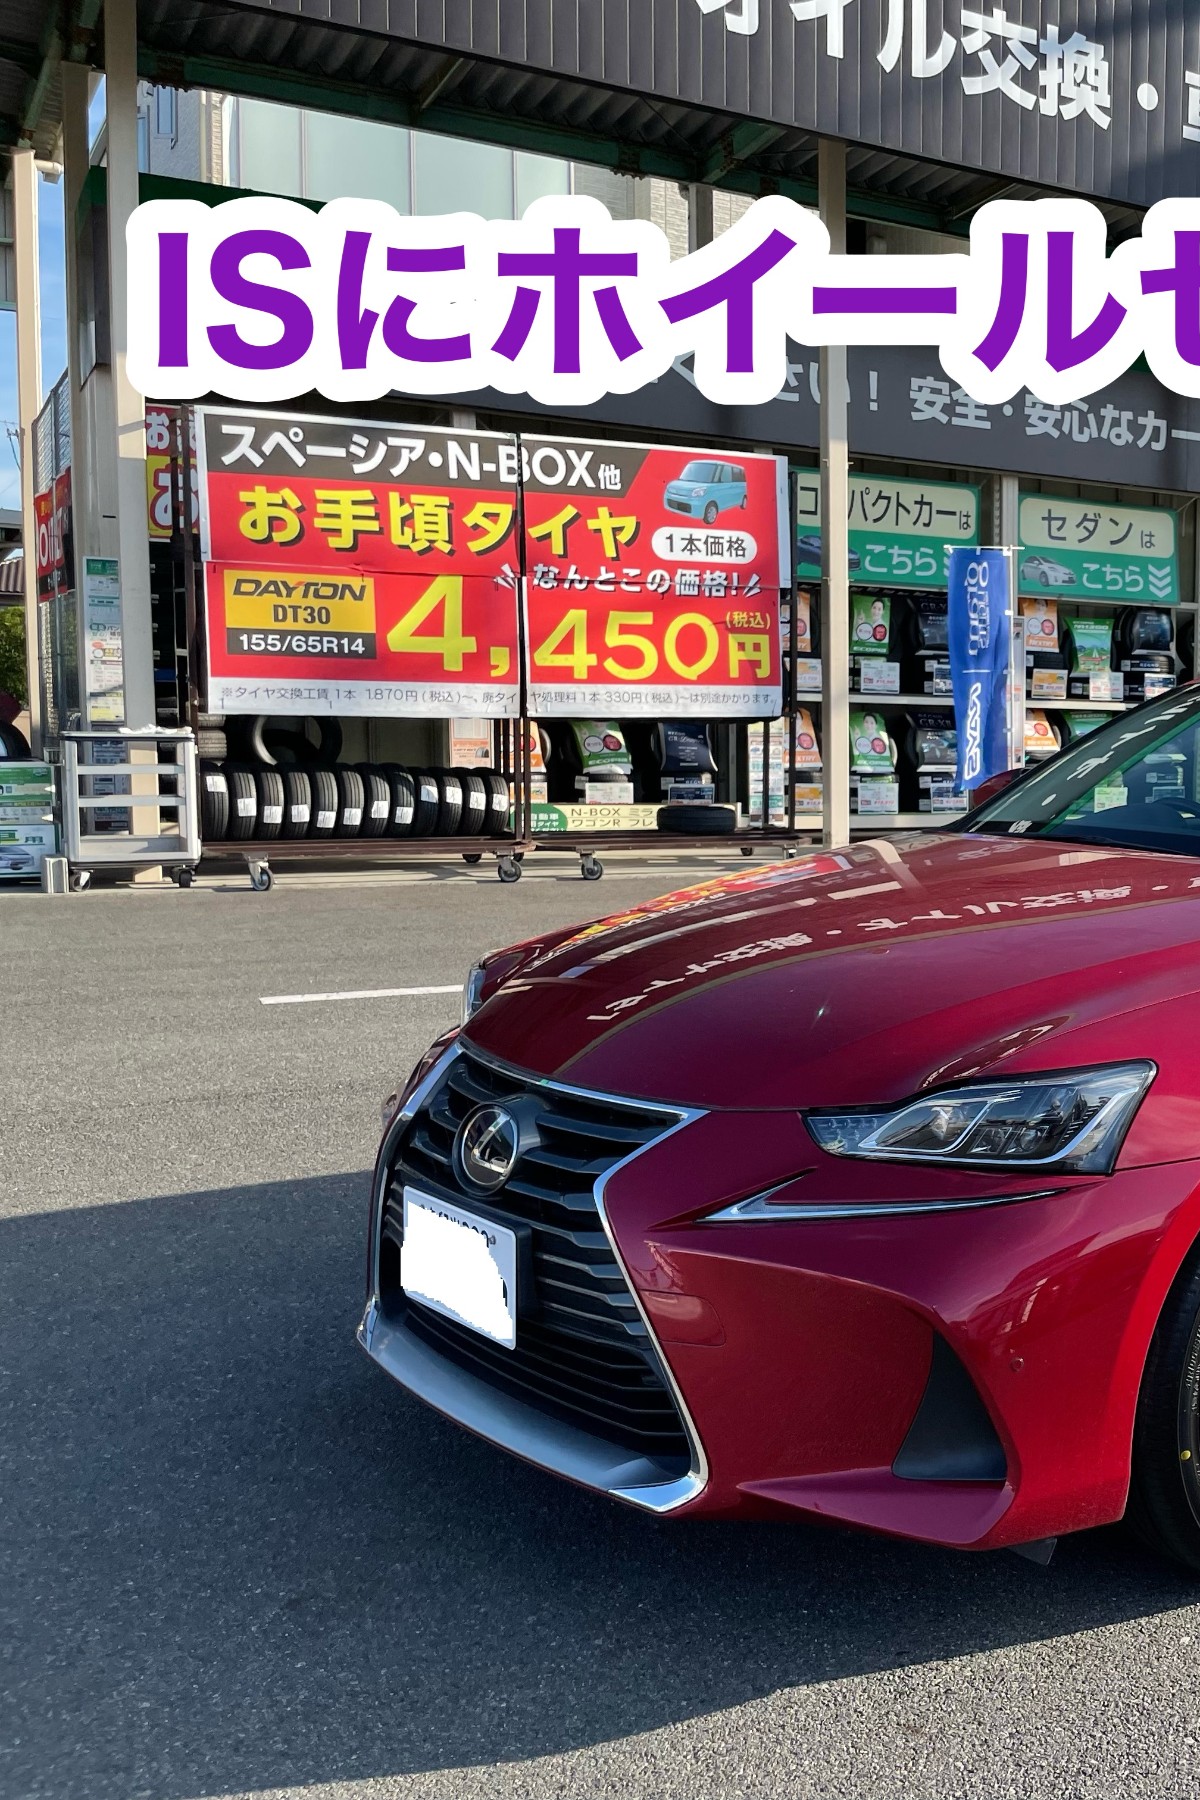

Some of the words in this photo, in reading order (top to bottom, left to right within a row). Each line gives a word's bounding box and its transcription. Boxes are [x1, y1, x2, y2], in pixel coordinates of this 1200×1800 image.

[238, 484, 640, 560] お手頃タイヤ
[799, 483, 972, 532] コパクトカーは
[663, 533, 749, 560] 1本価格
[865, 543, 938, 577] こちら
[232, 577, 367, 602] DAYTON
[1081, 562, 1144, 593] こちら
[272, 603, 331, 625] DT30
[239, 633, 366, 656] 155/65R14
